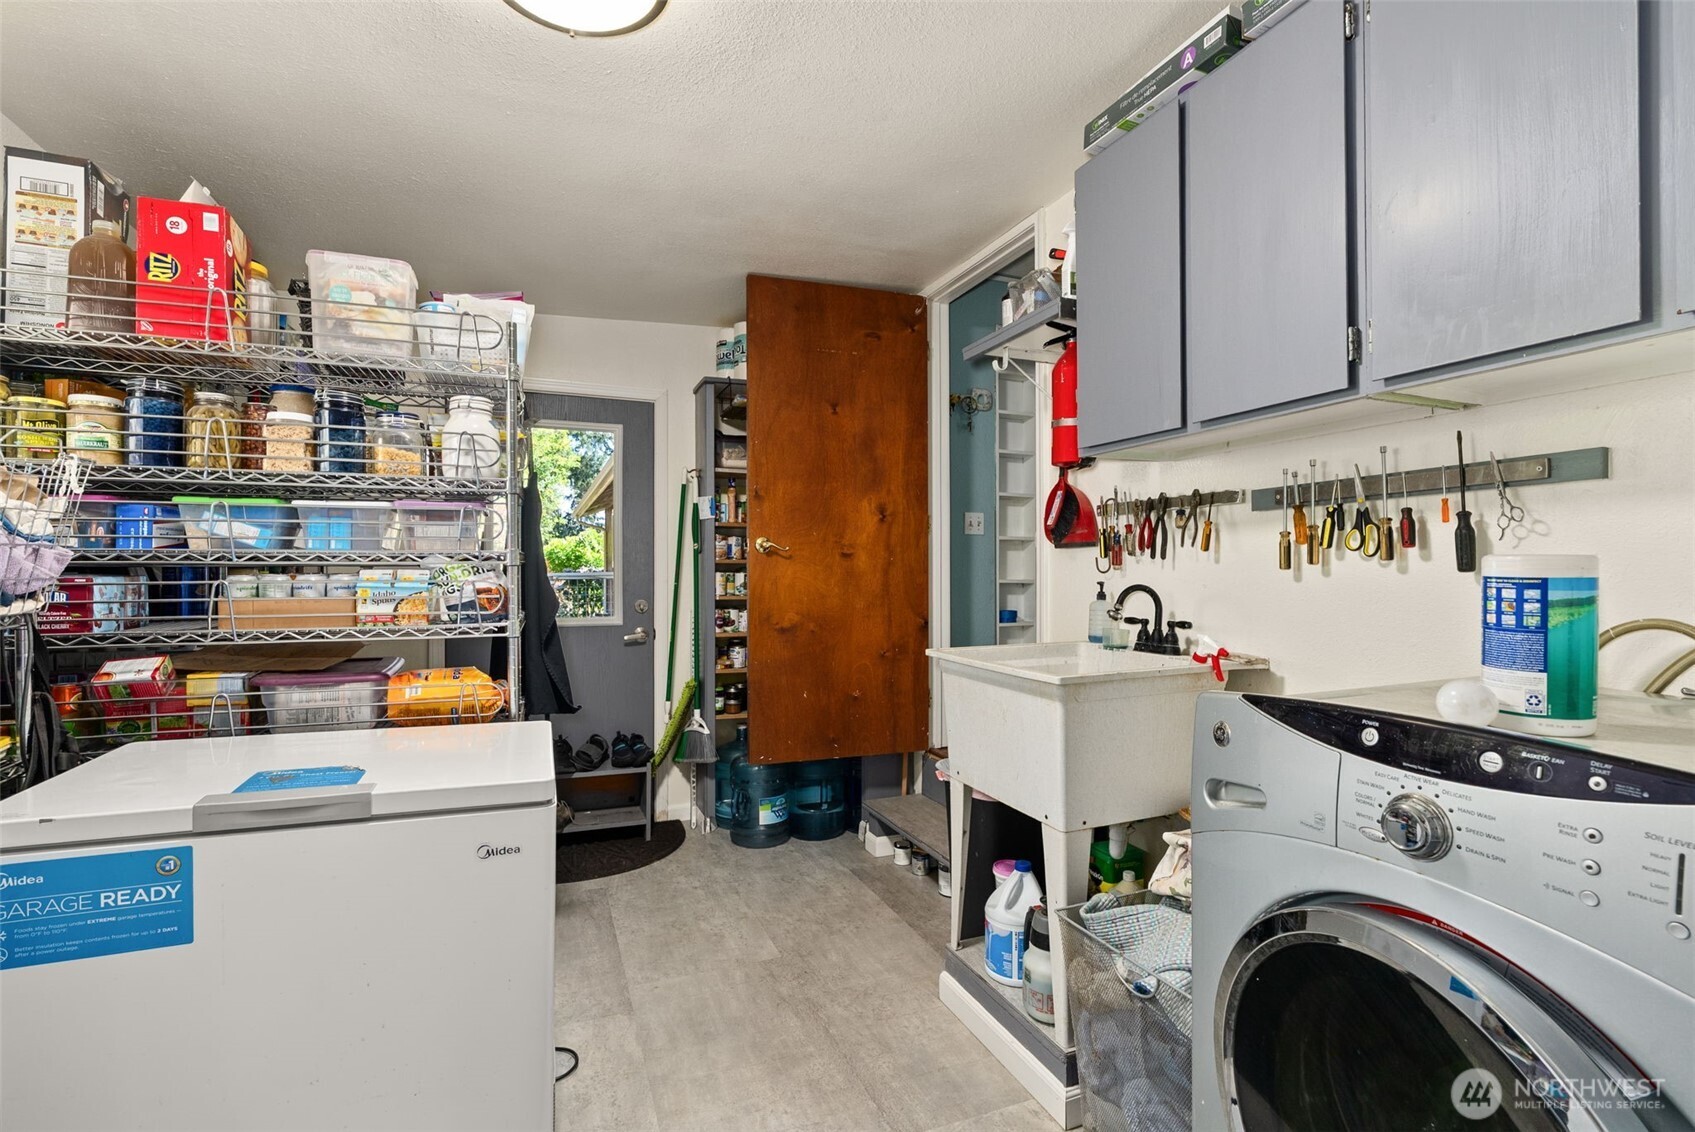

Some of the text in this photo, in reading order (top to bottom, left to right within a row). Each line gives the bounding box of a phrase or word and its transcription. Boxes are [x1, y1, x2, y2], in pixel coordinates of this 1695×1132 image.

[1182, 53, 1194, 69] A
[169, 220, 180, 230] 18
[148, 251, 174, 283] RITZ
[197, 268, 205, 278] the
[204, 257, 219, 289] original
[1362, 719, 1380, 727] POWER
[1589, 767, 1612, 776] START
[1590, 760, 1613, 770] DELAY
[1374, 771, 1400, 783] EASY CARE
[1404, 773, 1440, 787] ACTIVE WEAR
[1356, 779, 1386, 791] STAIN WASH
[1354, 791, 1373, 801] COLORS
[1441, 789, 1473, 802] DELICATES
[1355, 798, 1376, 809] NORMAL
[1355, 811, 1375, 822] WHITES
[1457, 807, 1497, 822] HAND WASH
[1557, 822, 1579, 832] EXTRA
[1464, 826, 1506, 843] SPEED WASH
[1558, 829, 1579, 839] RINSE
[1644, 831, 1666, 844] SOIL
[477, 844, 521, 860] Midea
[1465, 846, 1486, 858] DRAIN
[1491, 854, 1507, 864] SPIN
[1542, 852, 1577, 866] PRE WASH
[1641, 865, 1671, 877] NORMAL
[0, 872, 44, 890] Midea
[100, 884, 182, 908] READY
[1551, 884, 1576, 897] SIGNAL
[14, 926, 34, 934] Foods
[34, 925, 48, 934] stay
[48, 922, 68, 931] frozen
[87, 916, 117, 925] EXTREME
[117, 913, 137, 923] garage
[1440, 922, 1464, 936] DANGER
[14, 945, 34, 953] Better
[35, 942, 65, 952] insulation
[65, 939, 84, 949] keeps
[84, 935, 111, 944] contents
[111, 932, 130, 940] frozen
[140, 930, 149, 938] up
[36, 948, 56, 959] power
